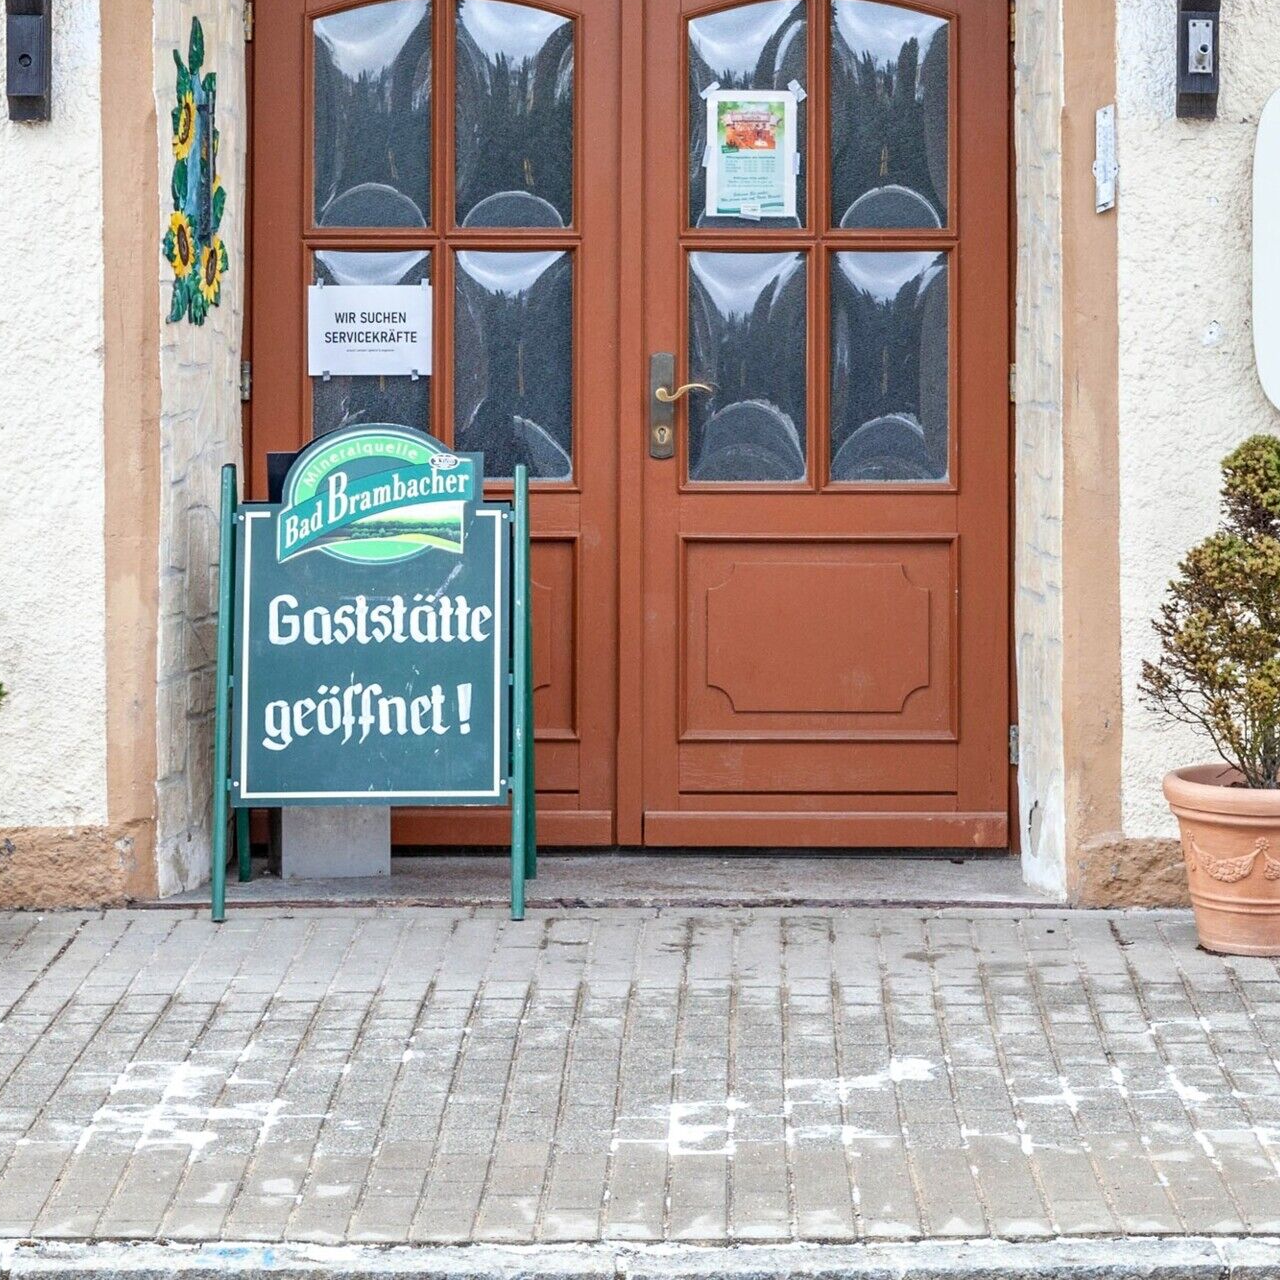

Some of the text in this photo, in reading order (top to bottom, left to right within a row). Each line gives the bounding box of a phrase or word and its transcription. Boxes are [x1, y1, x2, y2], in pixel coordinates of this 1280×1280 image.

[324, 328, 417, 343] SERVICEKRÄFTE
[334, 311, 407, 324] WIR SUCHEN
[303, 441, 418, 488] Mineralquelle
[285, 467, 470, 549] Bad Brambacher
[268, 593, 493, 645] Gaststätte
[262, 682, 472, 751] geöffnet!
